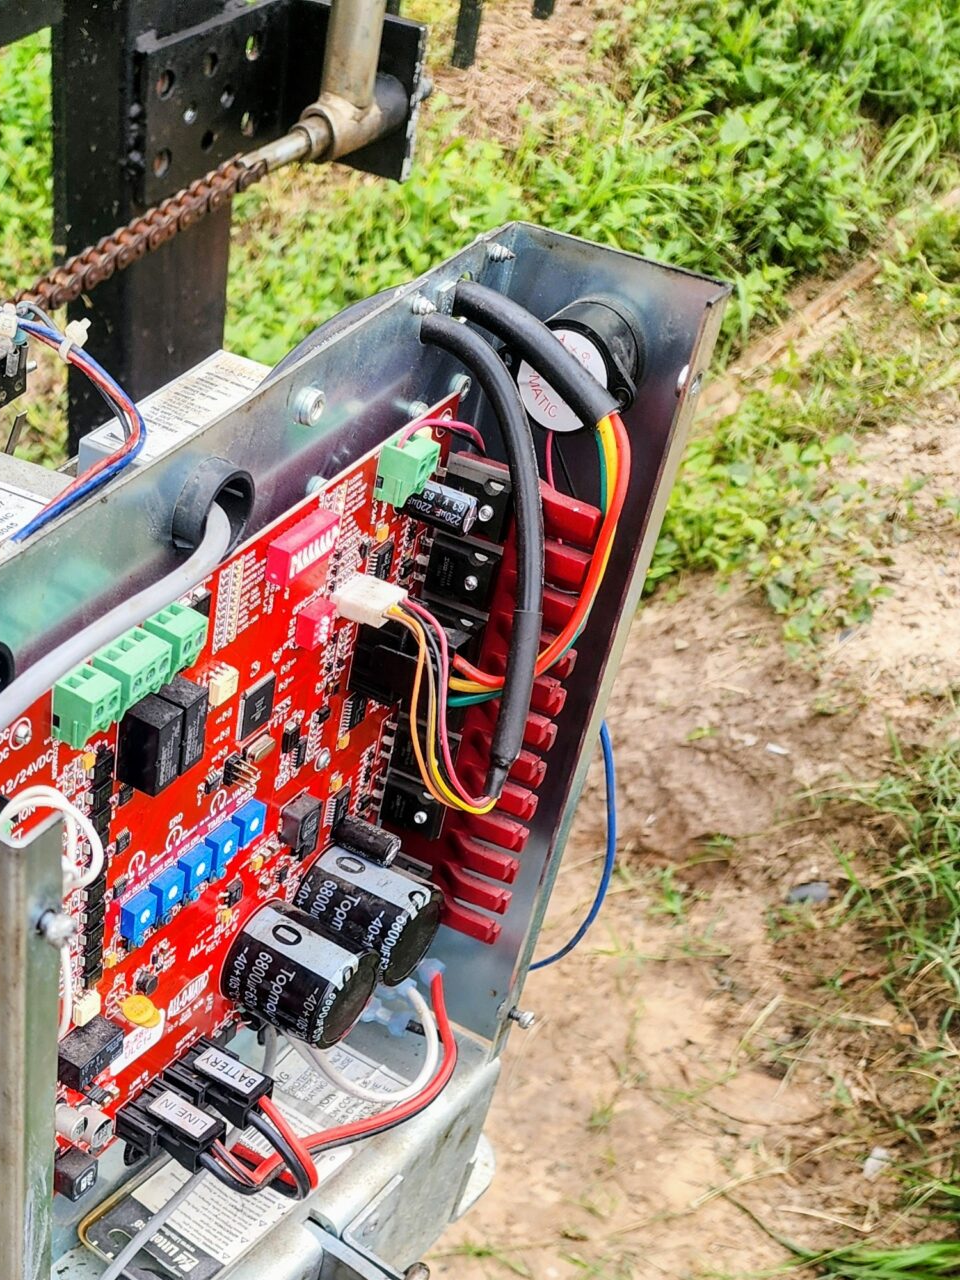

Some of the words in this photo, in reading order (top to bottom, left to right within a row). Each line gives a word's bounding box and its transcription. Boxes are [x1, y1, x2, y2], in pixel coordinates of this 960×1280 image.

[0, 748, 53, 796] 12/24VDC
[330, 894, 362, 932] Topm
[188, 909, 240, 961] ALL-BLDC
[201, 1053, 257, 1088] BATTERY
[159, 1098, 174, 1112] IN
[174, 1105, 208, 1131] LINE
